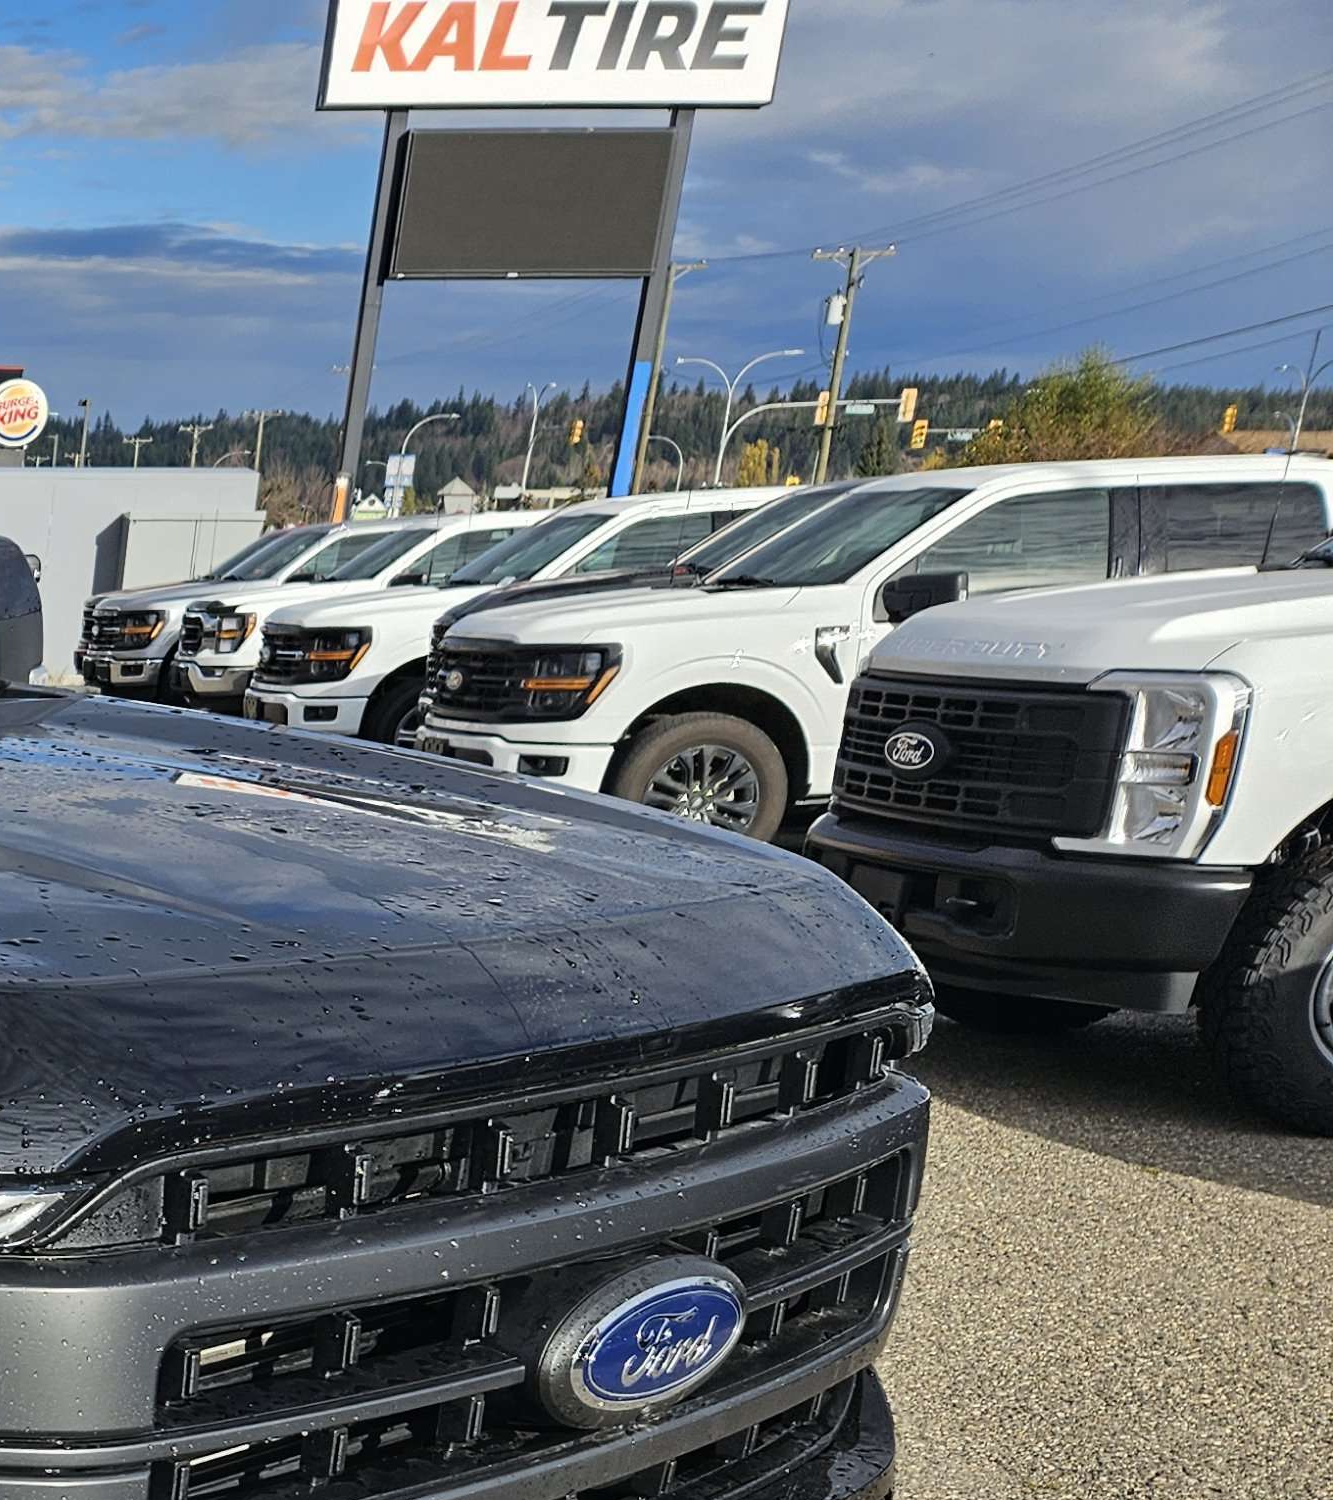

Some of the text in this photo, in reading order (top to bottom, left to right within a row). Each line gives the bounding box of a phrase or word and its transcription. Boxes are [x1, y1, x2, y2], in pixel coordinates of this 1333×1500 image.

[351, 0, 766, 72] KAL TIRE
[891, 735, 926, 764] Ford
[621, 1307, 719, 1387] Ford
